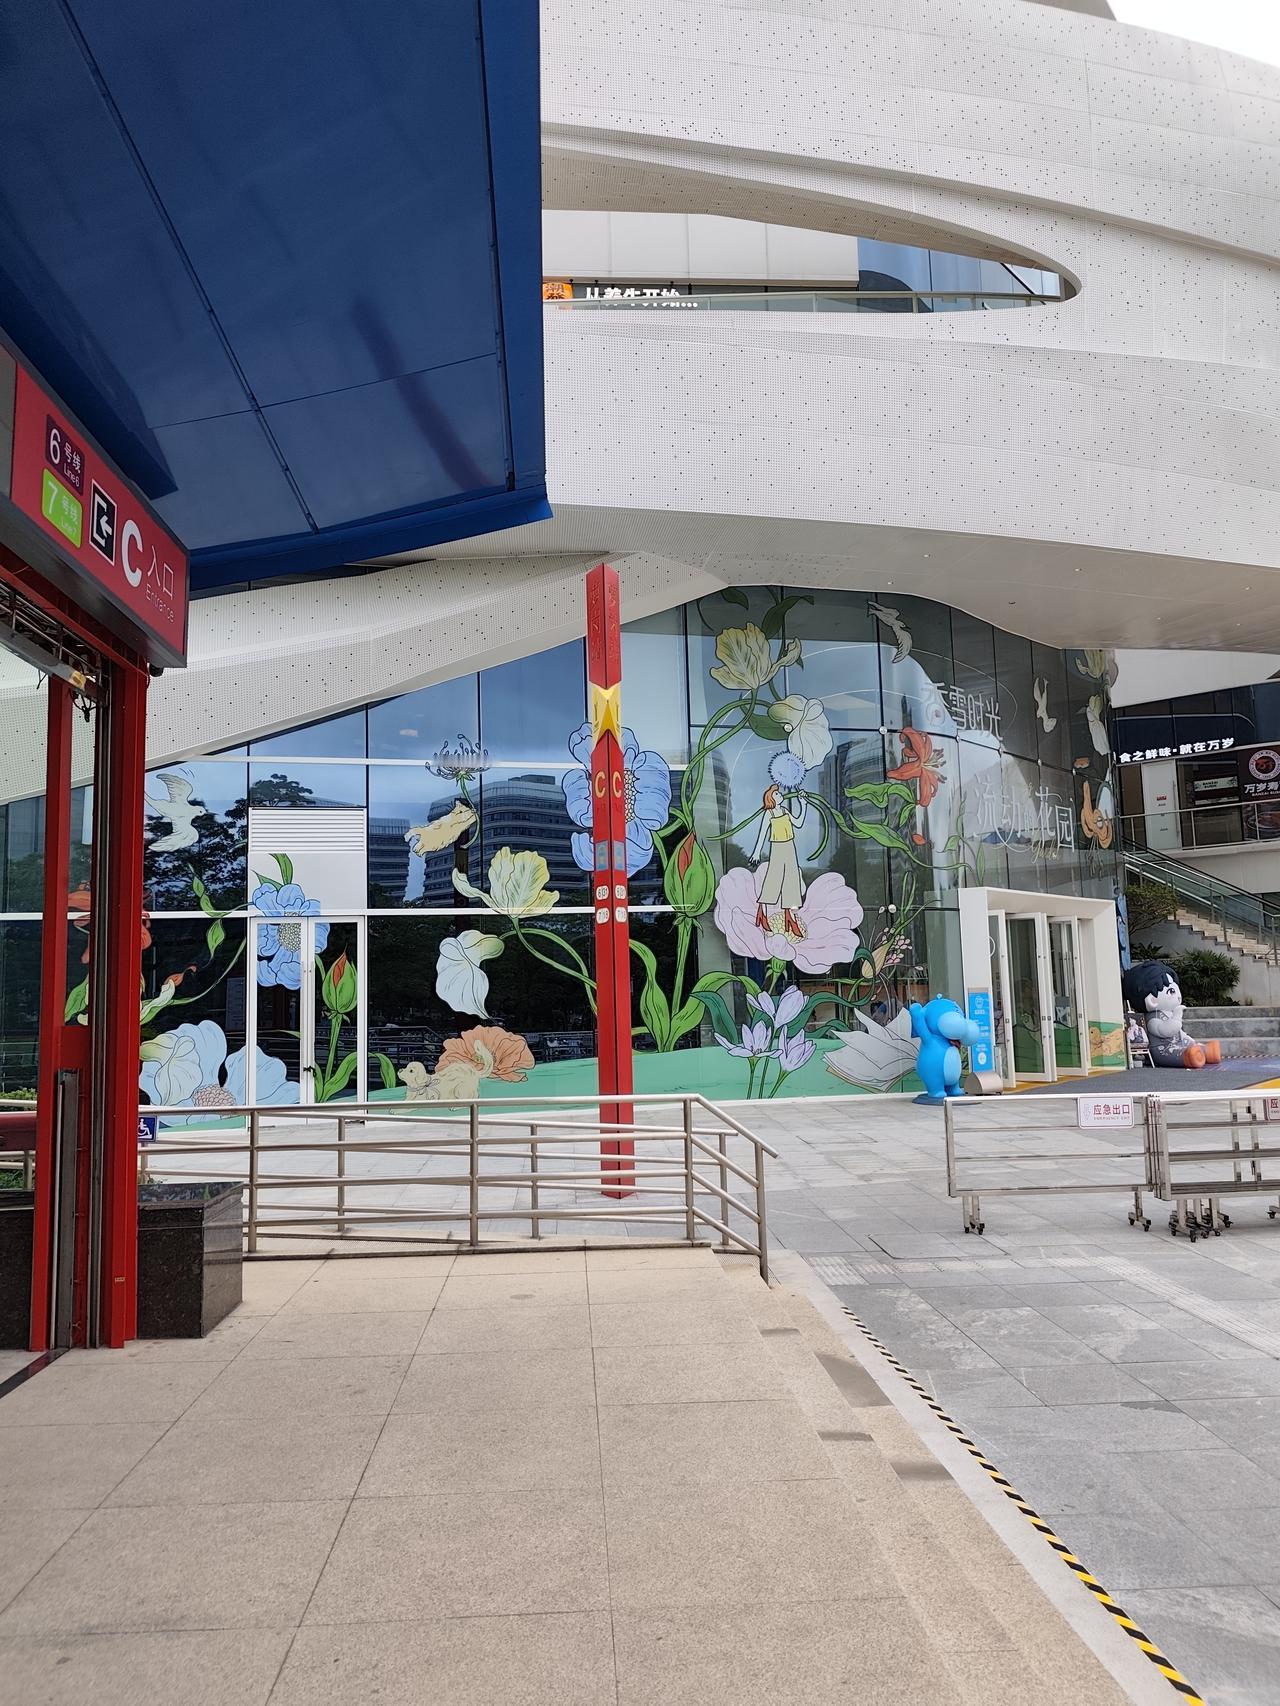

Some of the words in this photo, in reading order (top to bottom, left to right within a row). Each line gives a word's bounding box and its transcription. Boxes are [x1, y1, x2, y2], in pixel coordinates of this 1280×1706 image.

[121, 519, 143, 588] C
[147, 544, 174, 601] 入口
[594, 770, 606, 798] C
[612, 770, 622, 798] C
[1243, 780, 1280, 794] 万岁寿
[1093, 1103, 1130, 1115] 应急出口
